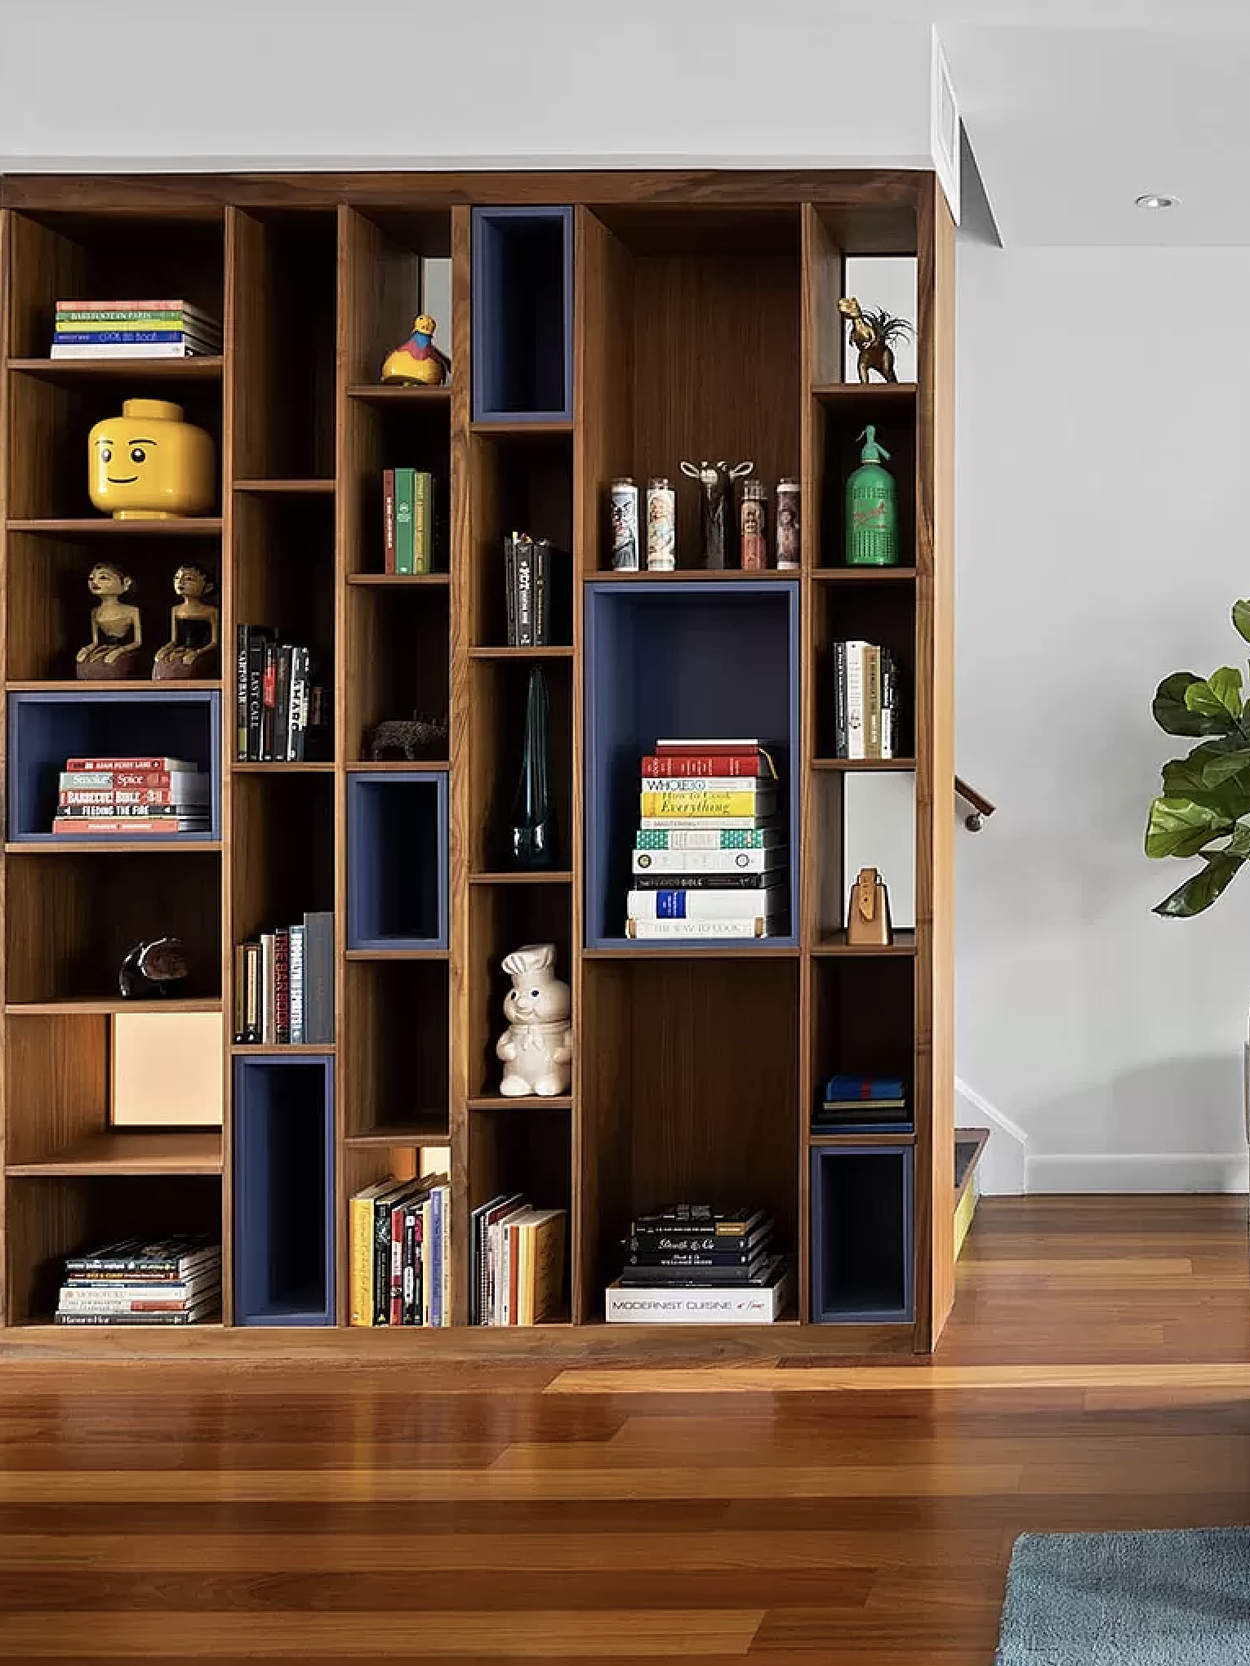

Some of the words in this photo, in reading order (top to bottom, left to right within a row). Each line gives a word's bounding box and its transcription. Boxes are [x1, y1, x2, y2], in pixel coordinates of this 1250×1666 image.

[251, 671, 260, 698] LAST
[250, 701, 259, 729] CALL
[117, 773, 143, 787] Spice
[662, 791, 684, 799] How
[690, 791, 700, 799] to
[703, 791, 730, 799] Cook
[82, 805, 114, 815] FEEDING
[116, 805, 130, 815] THE
[132, 805, 149, 815] FIRE
[660, 800, 731, 816] Everything
[674, 924, 695, 933] WAY
[698, 924, 711, 933] TO
[712, 924, 740, 933] COOK
[274, 933, 289, 961] THE
[274, 962, 289, 991] BAR
[274, 993, 289, 1029] BOOK
[611, 1301, 684, 1310] MODERNIST
[686, 1301, 733, 1310] CUISINE
